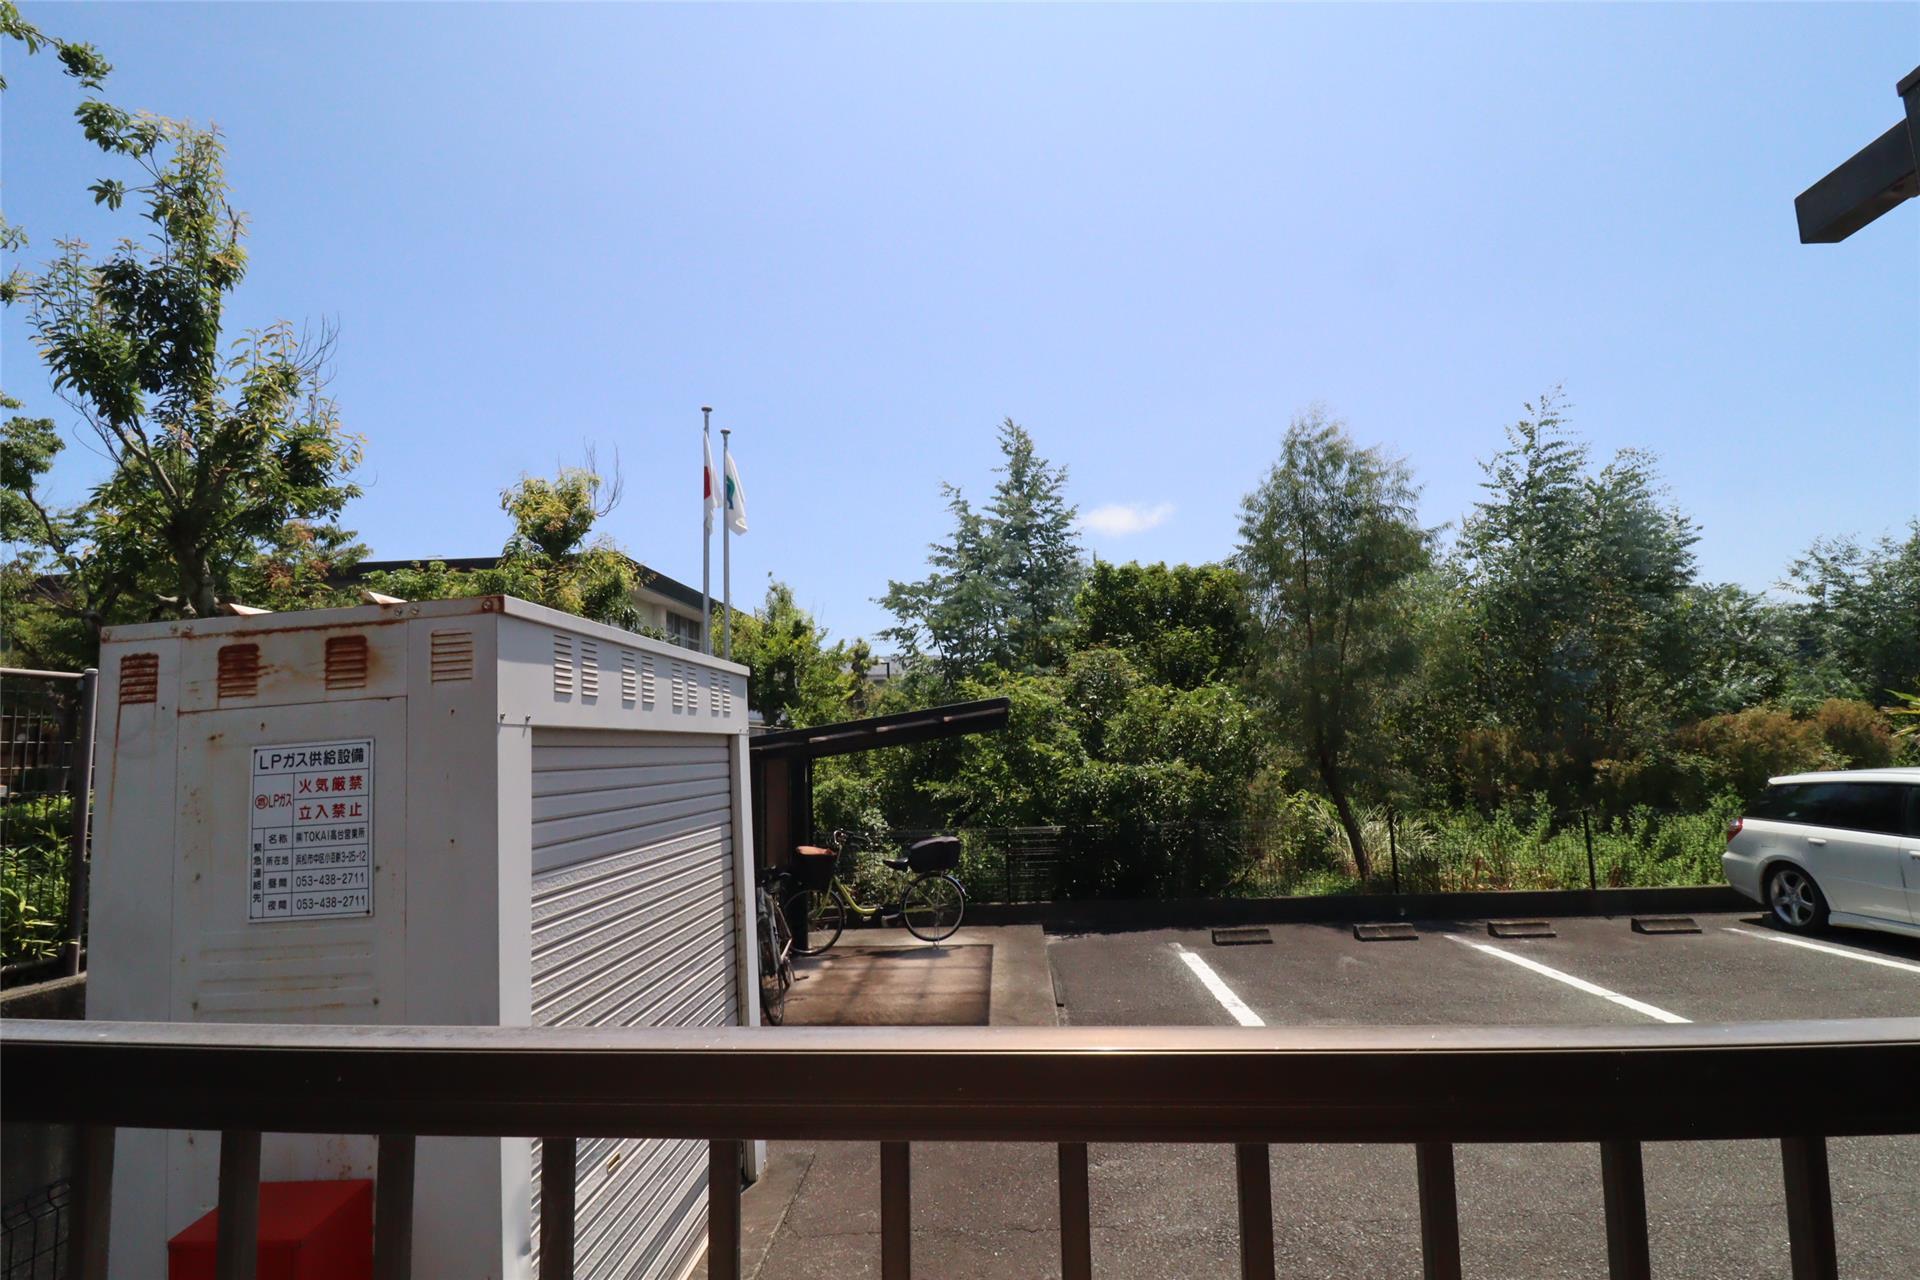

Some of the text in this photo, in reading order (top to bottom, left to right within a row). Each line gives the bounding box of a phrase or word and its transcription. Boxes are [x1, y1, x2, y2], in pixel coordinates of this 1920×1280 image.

[259, 748, 364, 770] LPガス供給設備
[298, 776, 363, 794] 火気厳禁
[298, 802, 363, 820] 立入禁止
[268, 833, 288, 844] 名称
[266, 855, 289, 866] 所在地
[296, 872, 364, 888] 053-438-2711
[296, 895, 365, 911] 053-438-2711
